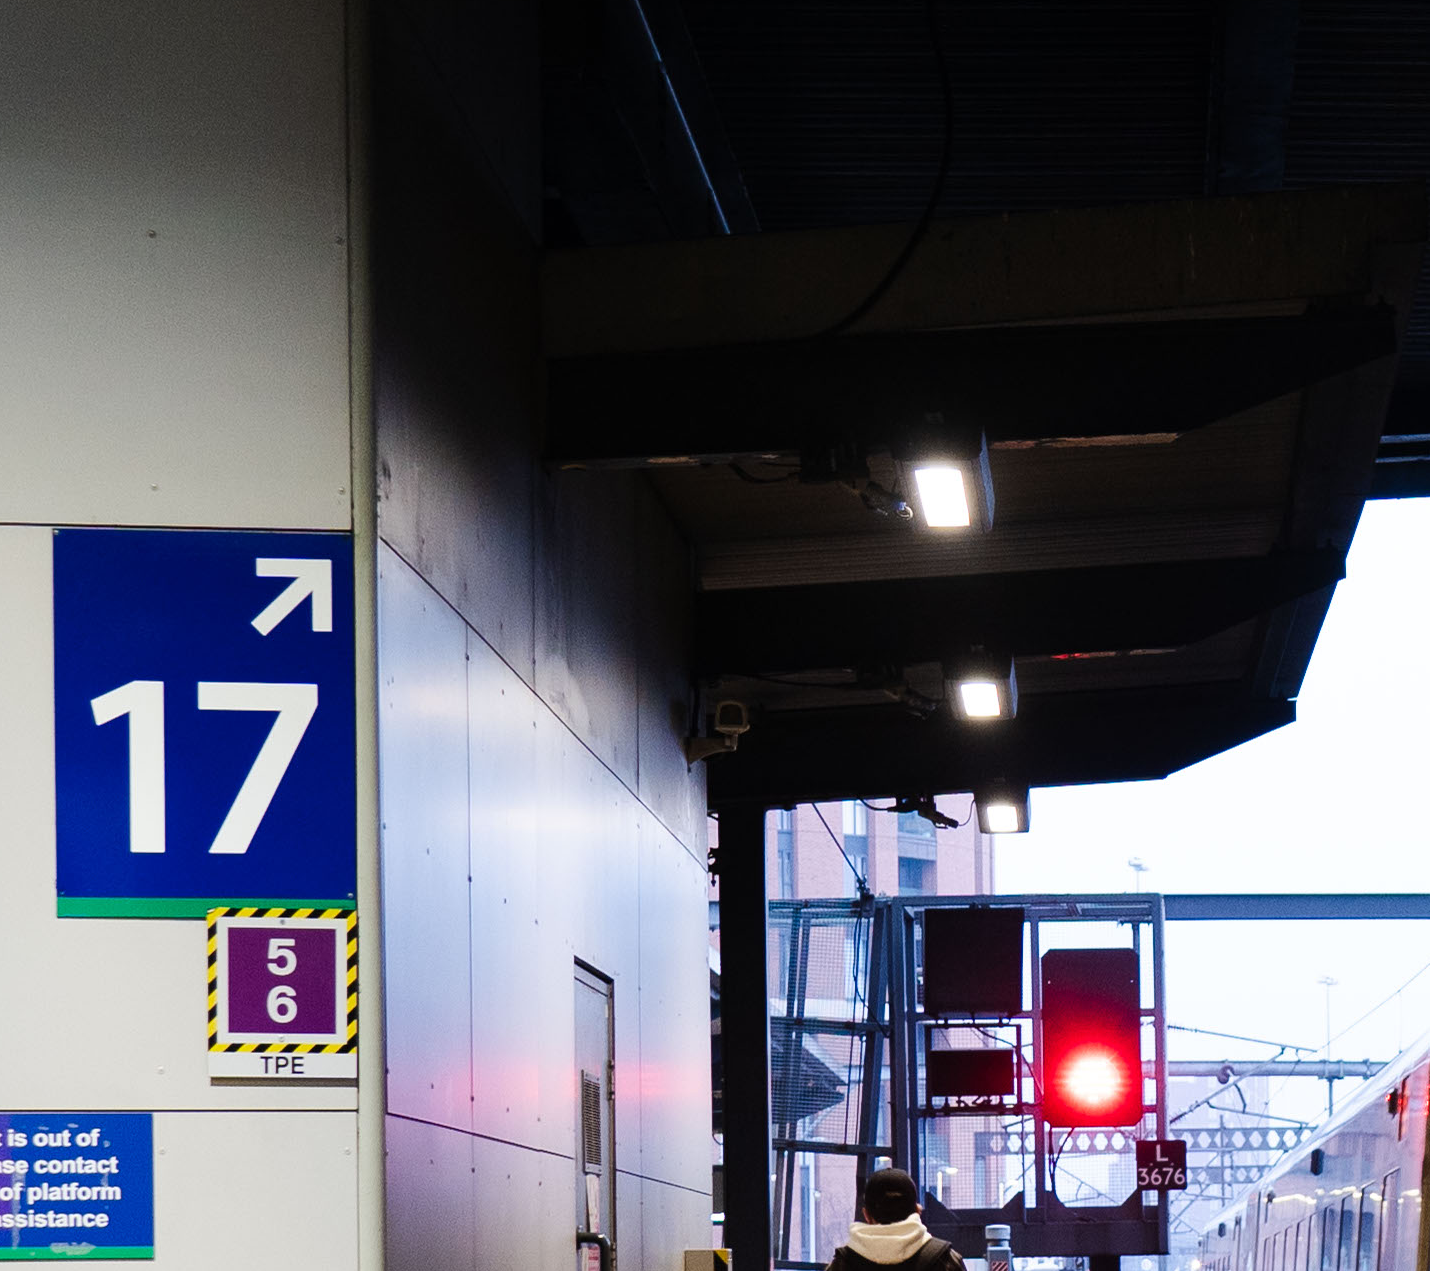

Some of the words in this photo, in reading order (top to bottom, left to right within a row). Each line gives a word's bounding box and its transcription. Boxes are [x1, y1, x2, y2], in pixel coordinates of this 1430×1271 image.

[90, 680, 319, 855] 17
[267, 938, 297, 976] 5
[266, 985, 298, 1023] 6
[260, 1056, 305, 1074] TPE
[7, 1129, 28, 1147] is
[32, 1130, 71, 1147] out
[75, 1128, 100, 1147] of
[1155, 1144, 1169, 1162] L
[33, 1156, 119, 1174] contact
[1138, 1167, 1186, 1186] 3676
[27, 1183, 121, 1205] platform
